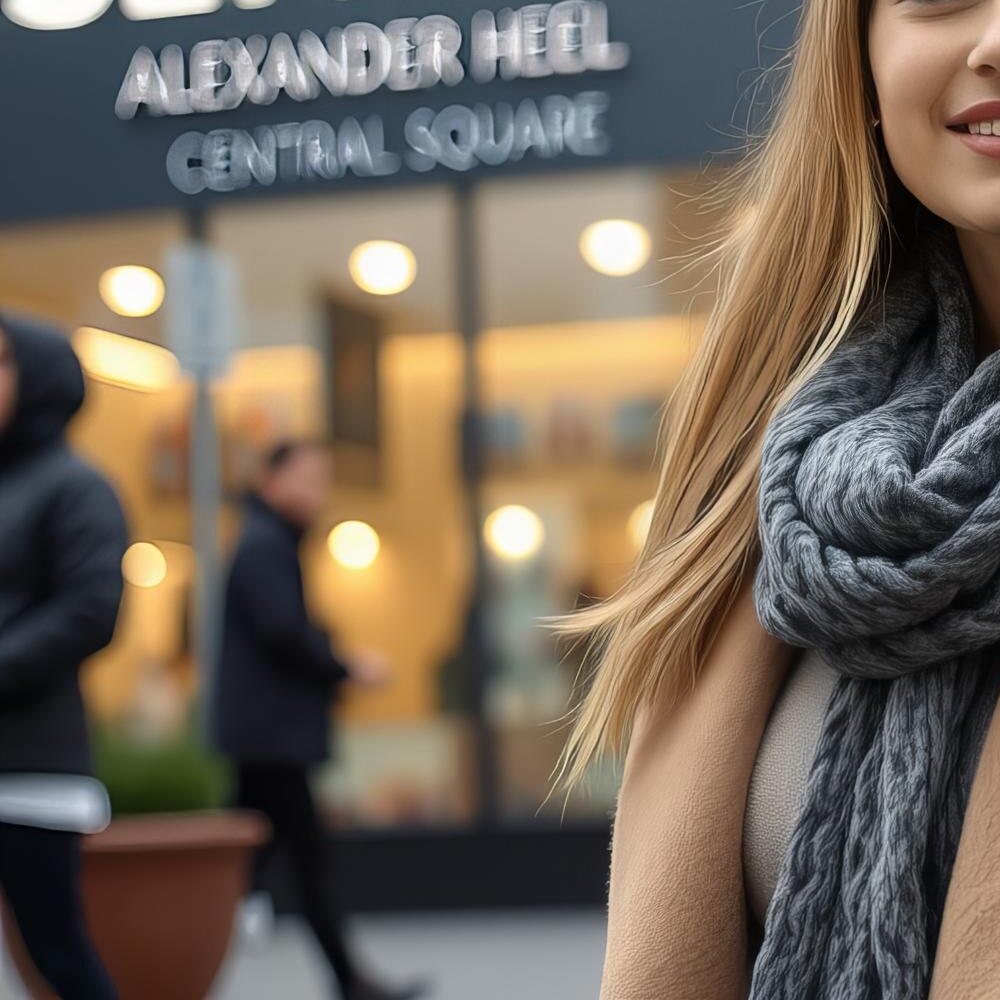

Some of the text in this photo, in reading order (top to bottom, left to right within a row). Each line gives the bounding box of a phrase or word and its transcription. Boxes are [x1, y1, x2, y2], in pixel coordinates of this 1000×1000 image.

[114, 14, 464, 120] ALEXANDER
[166, 91, 611, 194] CENTRAL SQUARE
